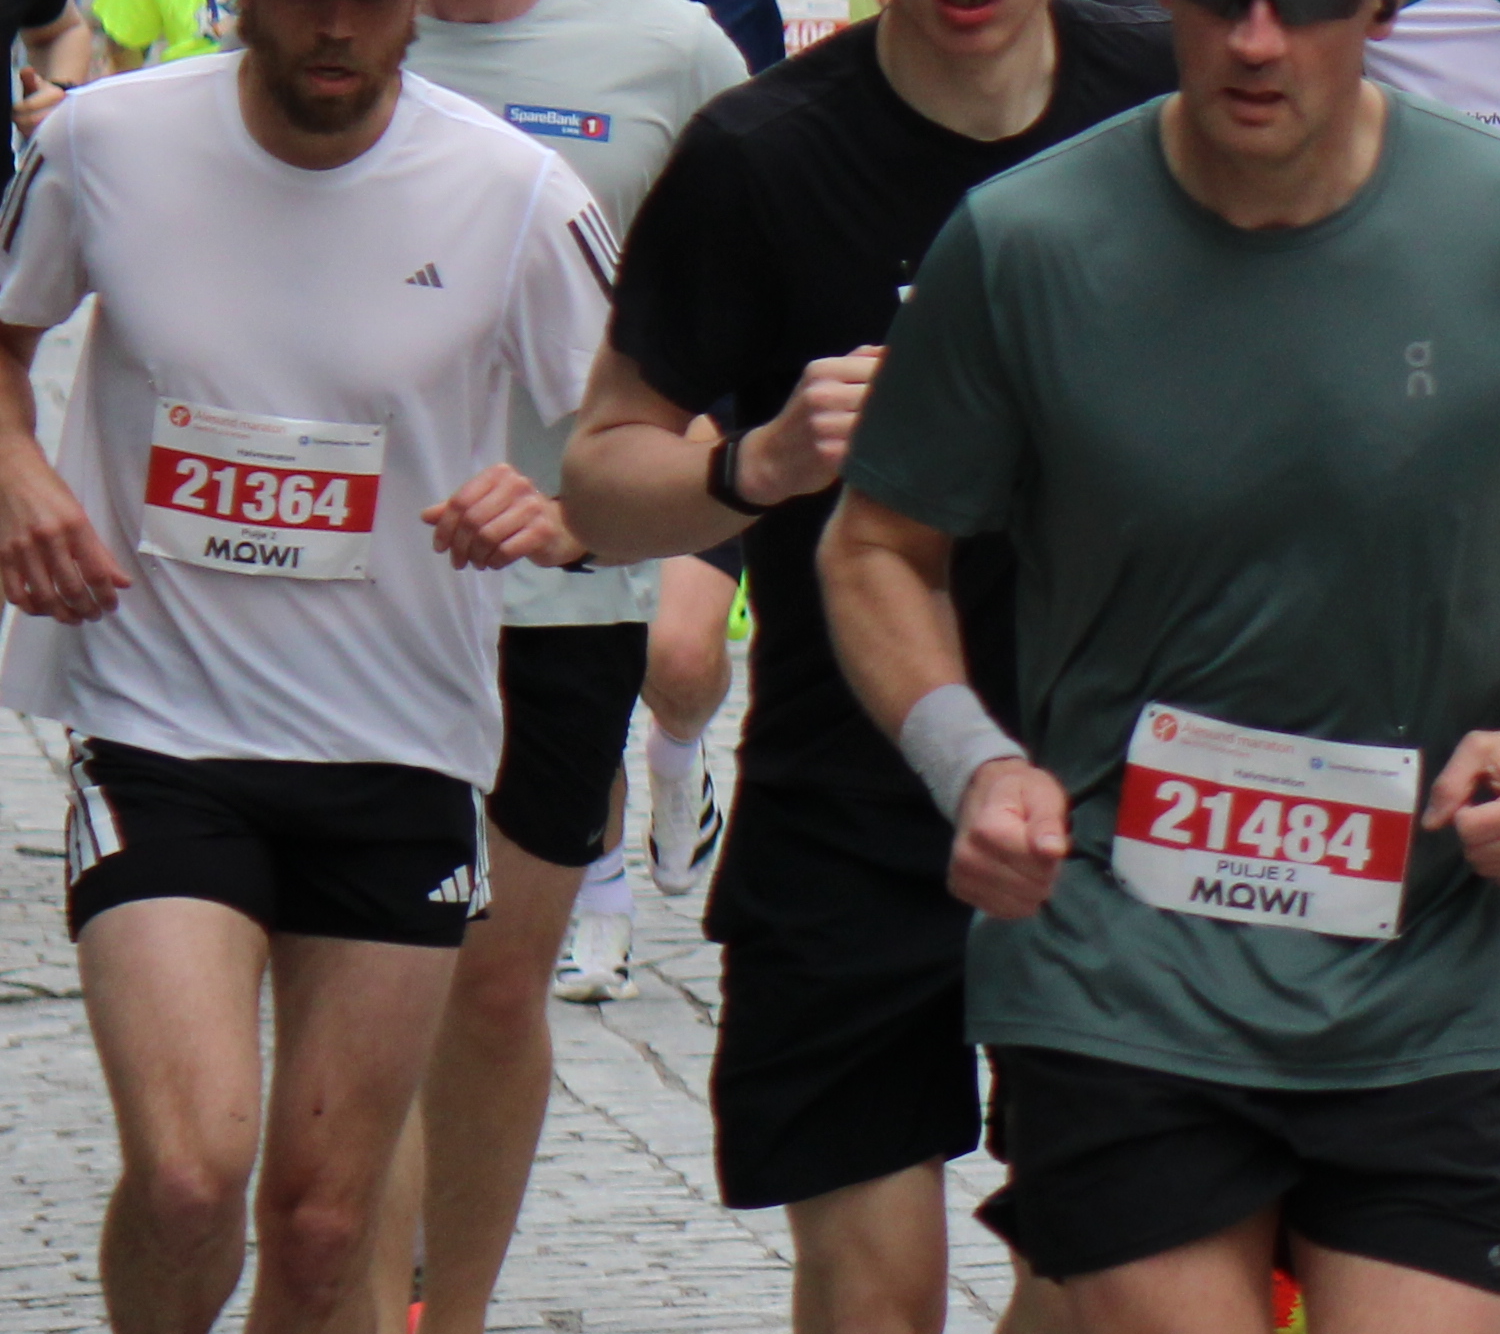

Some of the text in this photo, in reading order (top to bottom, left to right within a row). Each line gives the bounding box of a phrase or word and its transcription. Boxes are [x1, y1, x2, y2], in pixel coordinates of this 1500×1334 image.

[510, 107, 580, 127] SpareBank
[171, 458, 350, 527] 21364
[1149, 779, 1373, 872] 21484
[1215, 859, 1297, 882] PULJE 2
